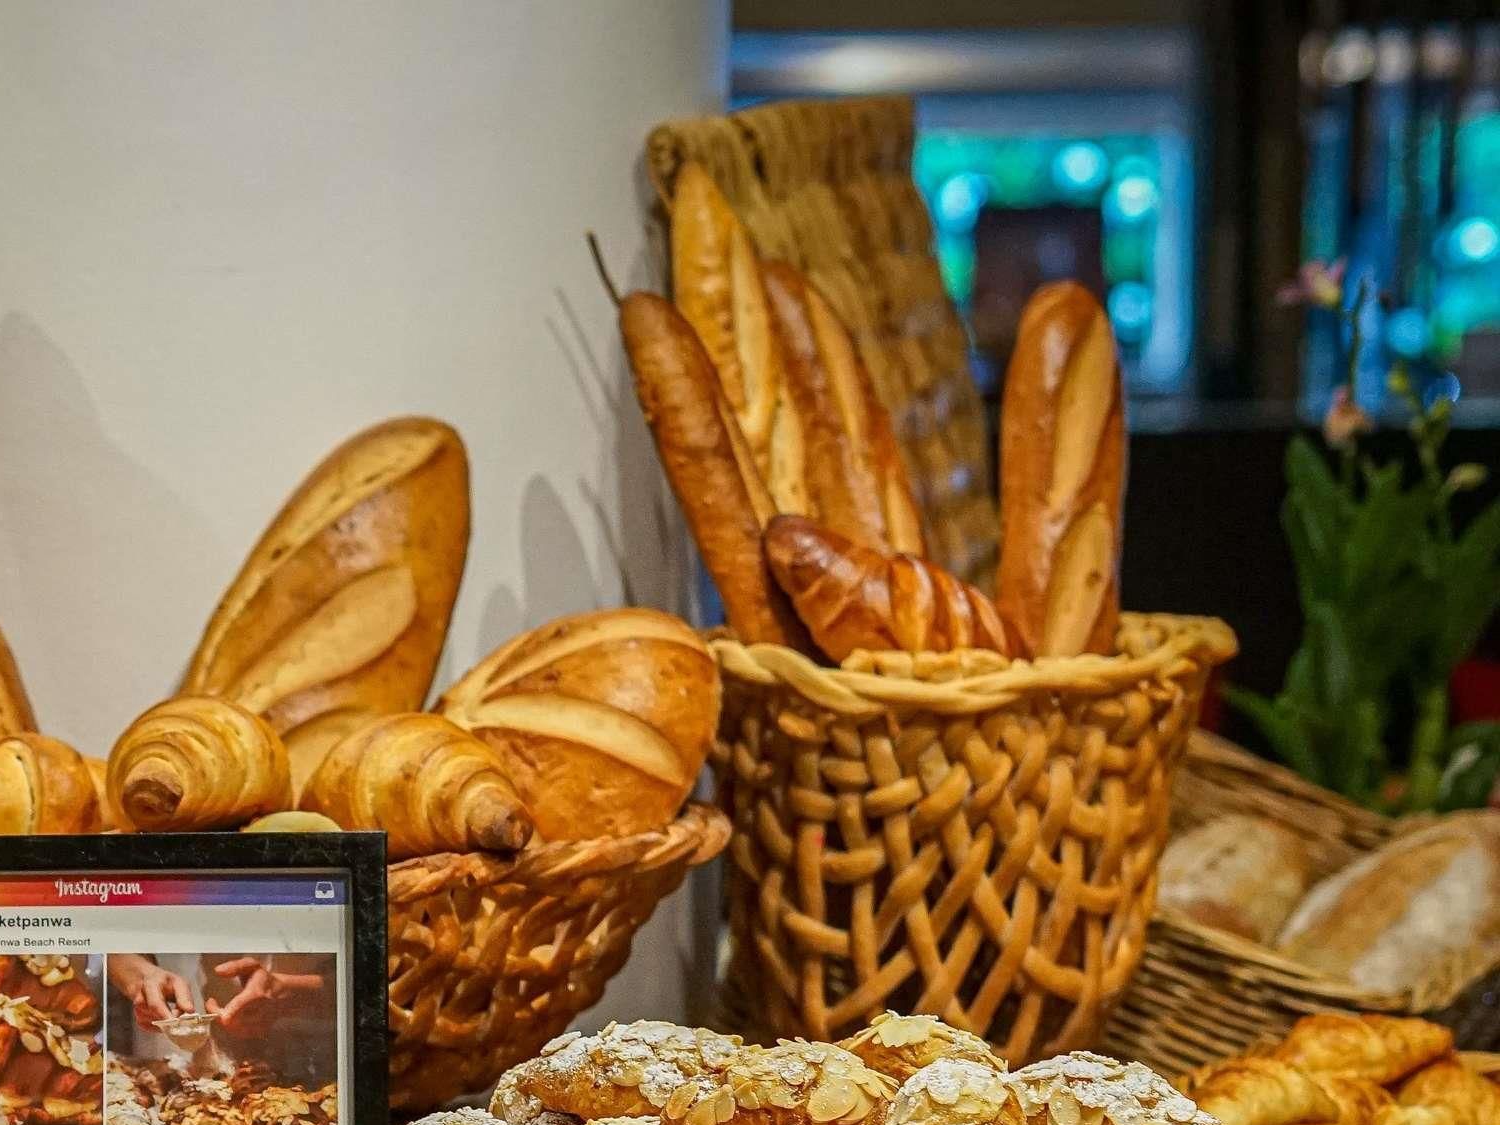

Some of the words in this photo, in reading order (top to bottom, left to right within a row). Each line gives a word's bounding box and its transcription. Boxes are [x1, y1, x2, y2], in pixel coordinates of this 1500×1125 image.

[55, 879, 143, 903] Instagram
[23, 938, 55, 947] Beach
[58, 937, 91, 947] Resort
